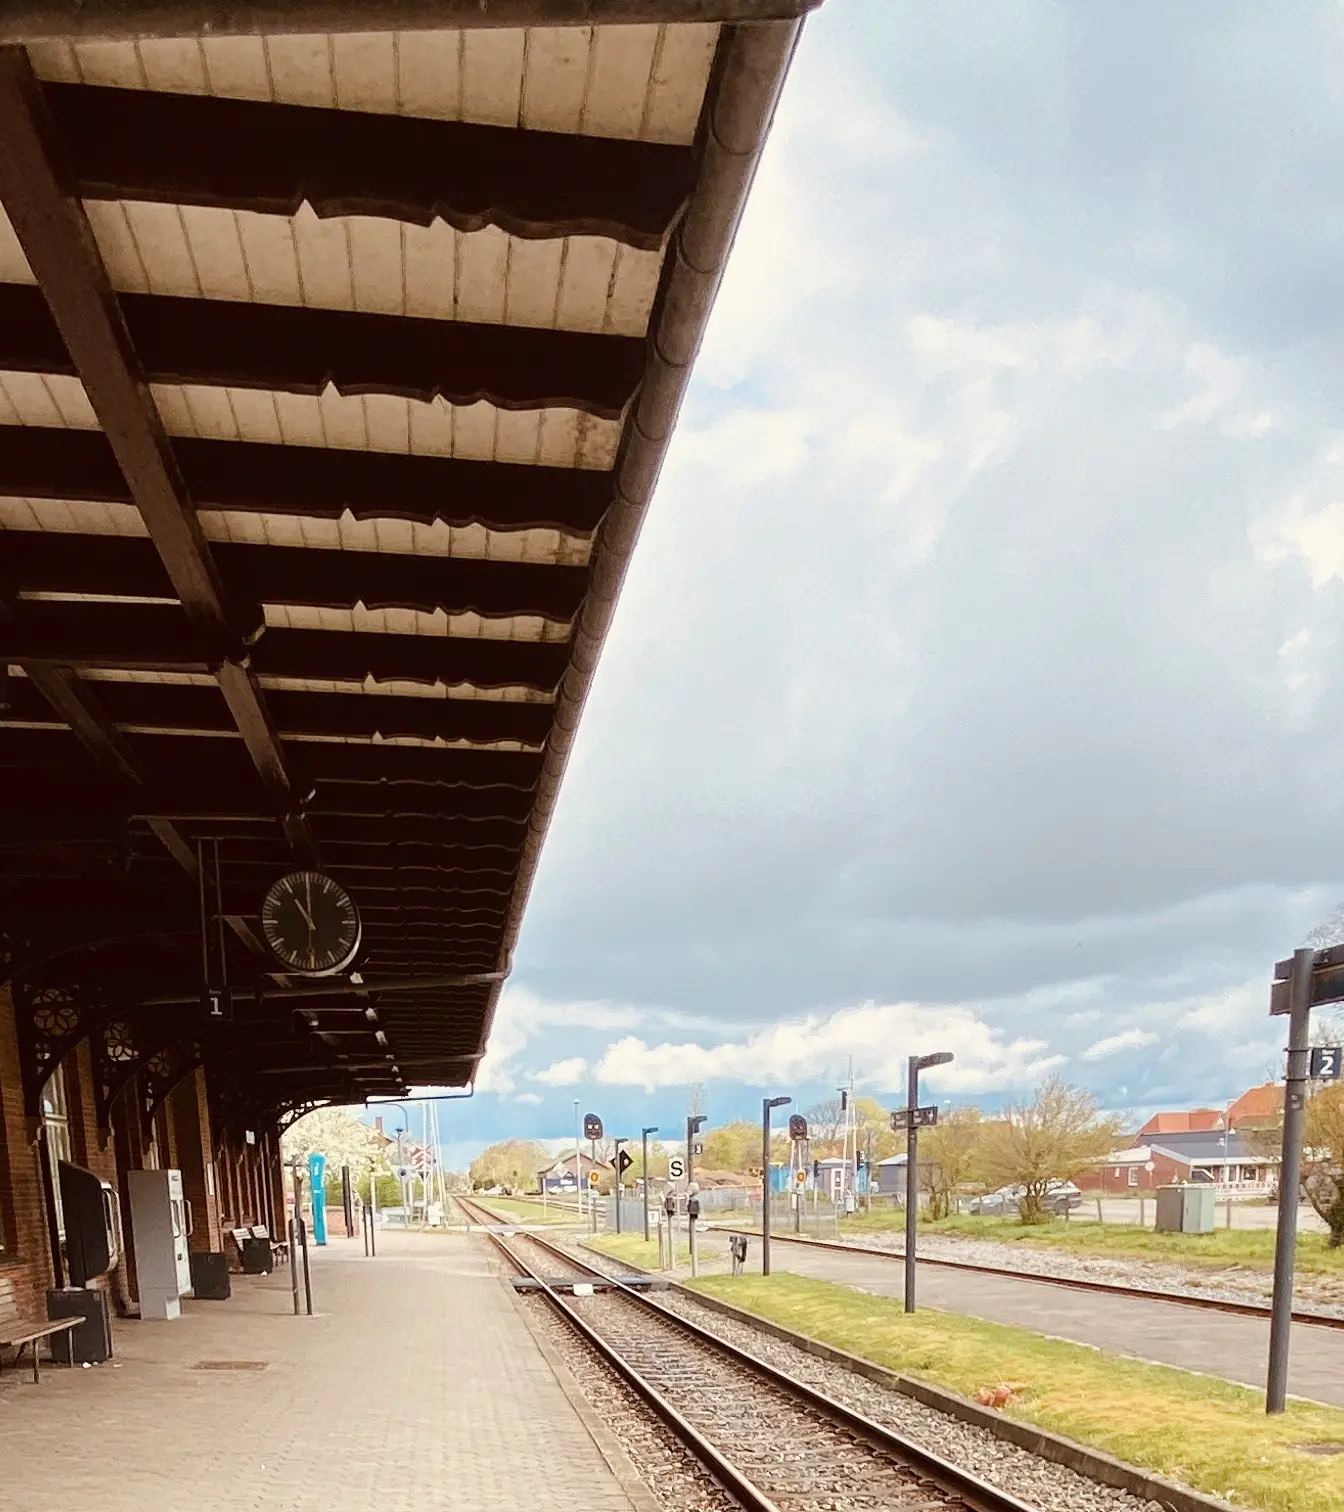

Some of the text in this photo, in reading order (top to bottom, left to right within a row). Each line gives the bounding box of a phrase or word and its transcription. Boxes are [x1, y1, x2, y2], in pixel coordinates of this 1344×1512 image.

[210, 997, 223, 1016] 1
[1320, 1056, 1334, 1075] 2
[671, 1160, 683, 1177] S
